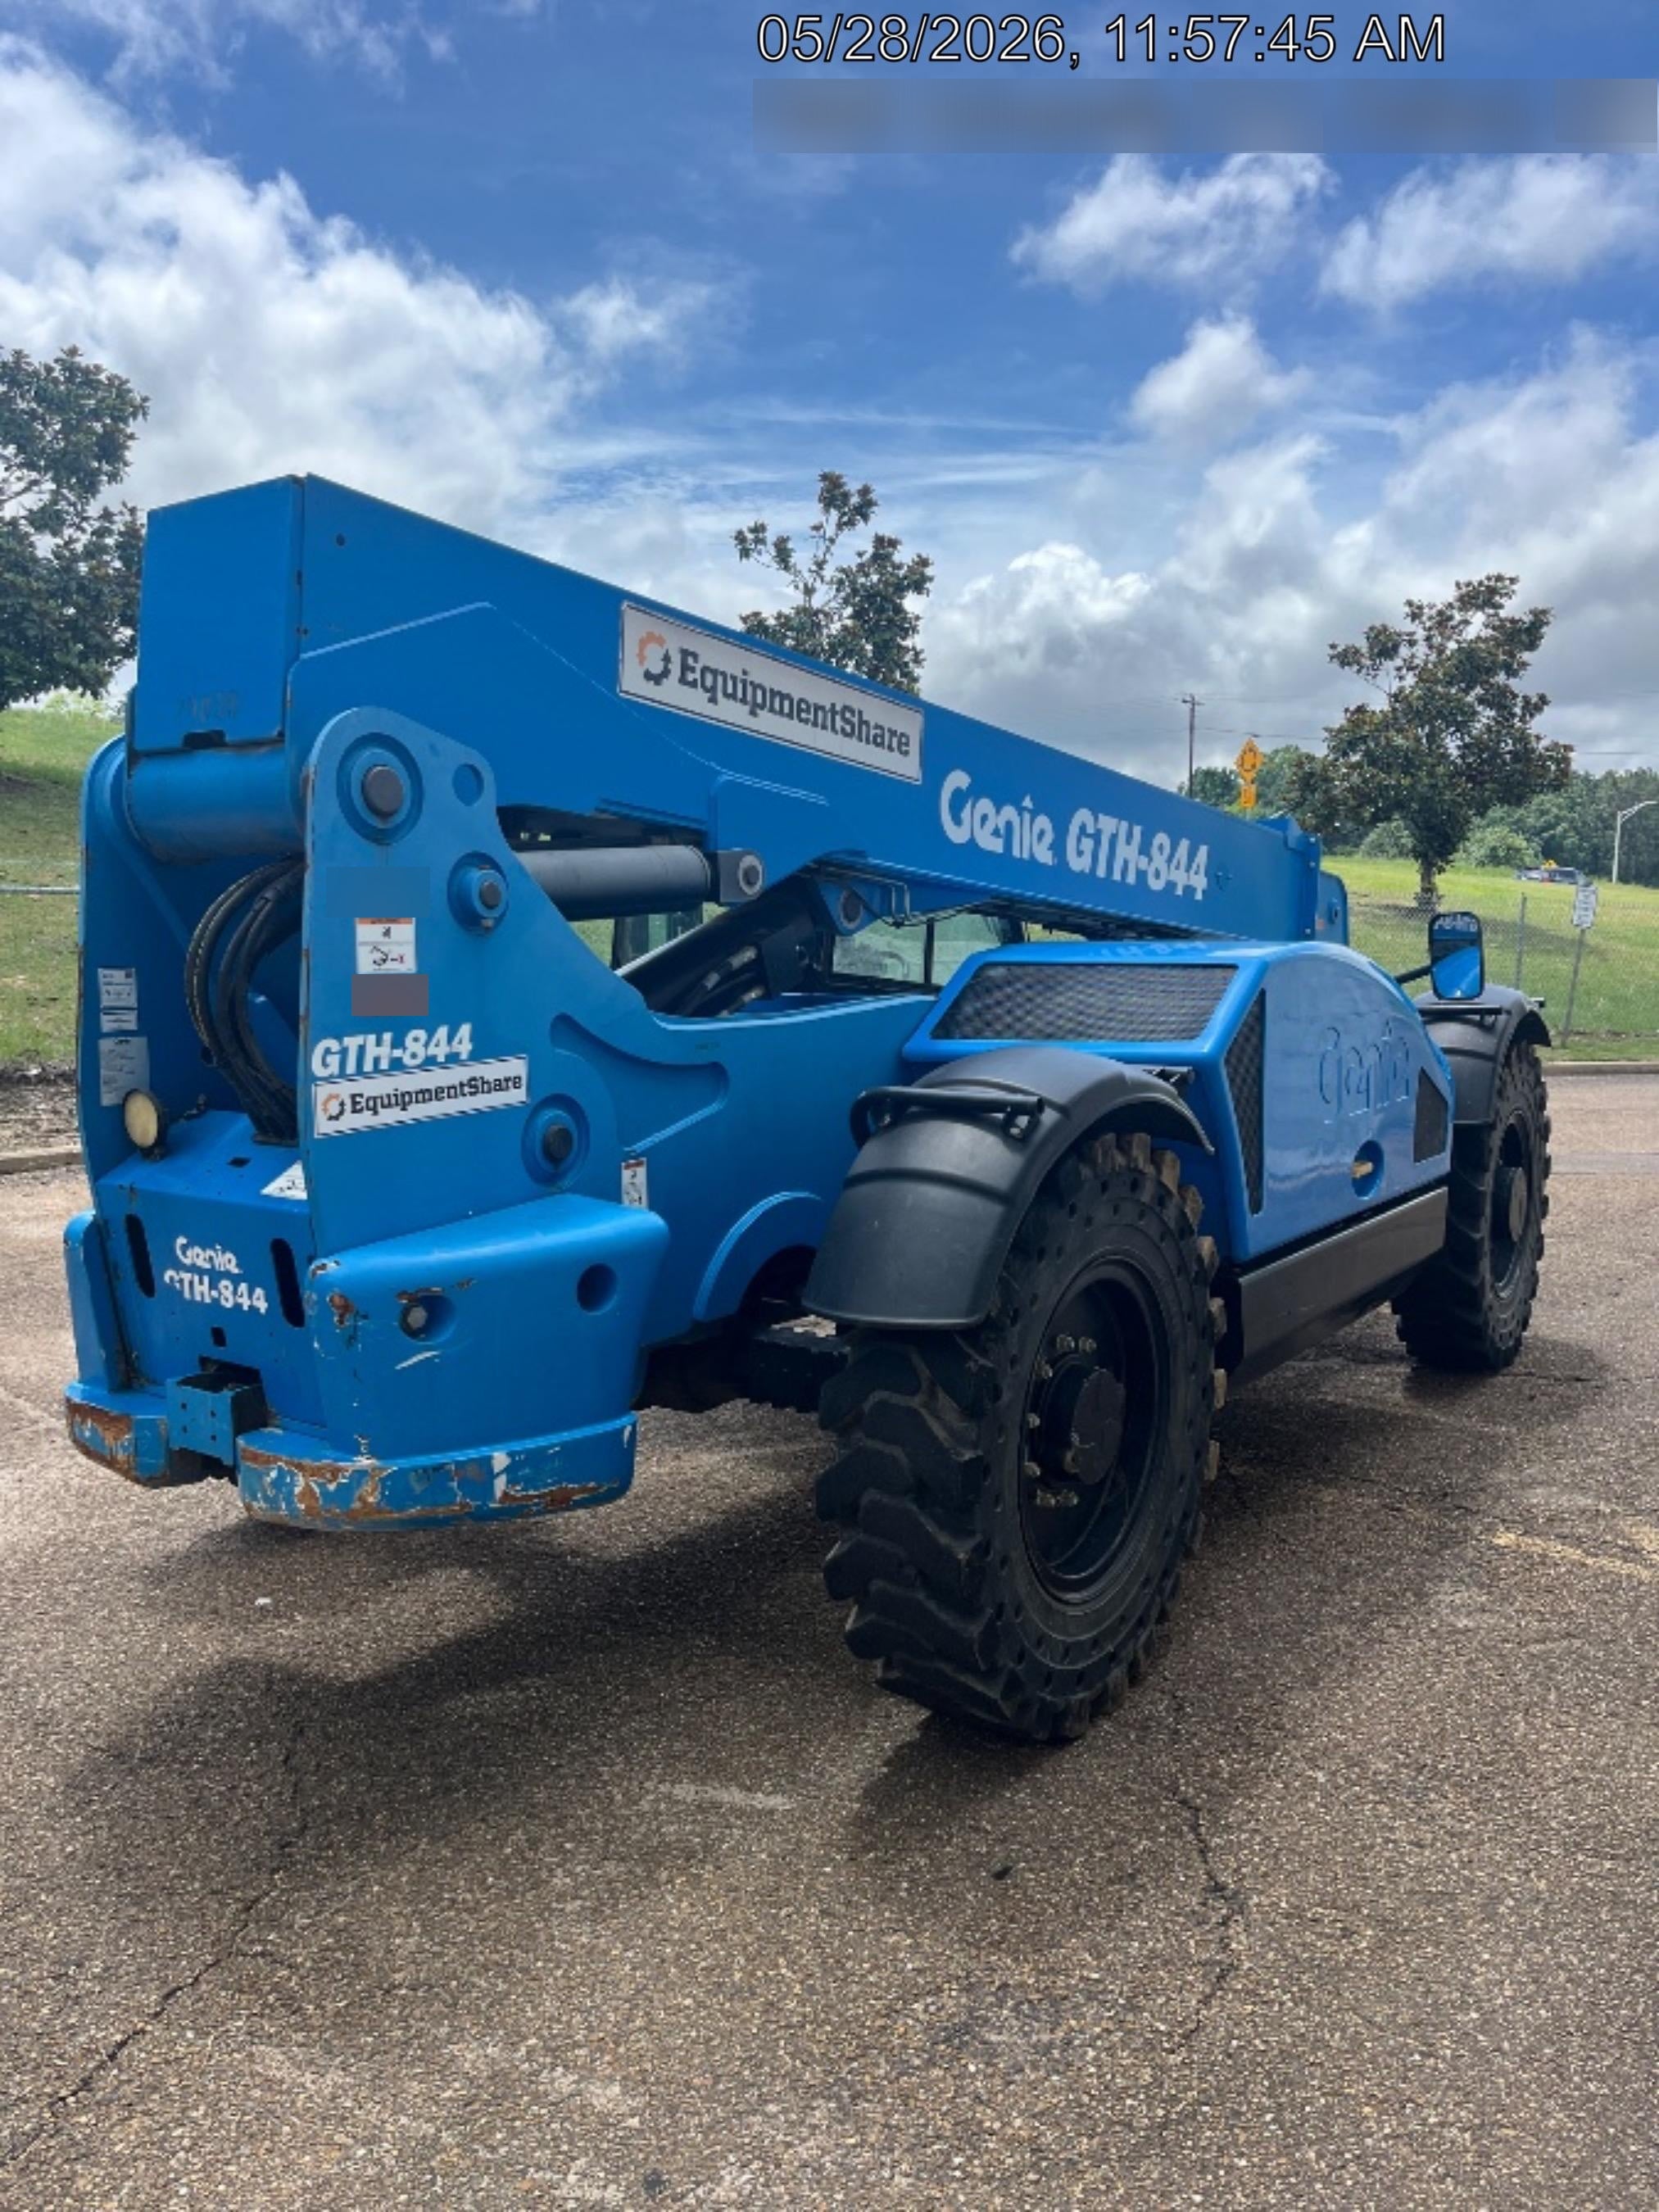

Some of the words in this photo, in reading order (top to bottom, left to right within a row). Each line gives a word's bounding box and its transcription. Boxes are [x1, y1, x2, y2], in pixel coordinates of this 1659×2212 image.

[678, 646, 911, 758] EquipmentShare
[940, 768, 1056, 866] Genie
[1067, 808, 1209, 900] GTH-844
[311, 1022, 472, 1077] GTH-844
[350, 1075, 522, 1116] EquipmentShare
[175, 1235, 243, 1275] Genie
